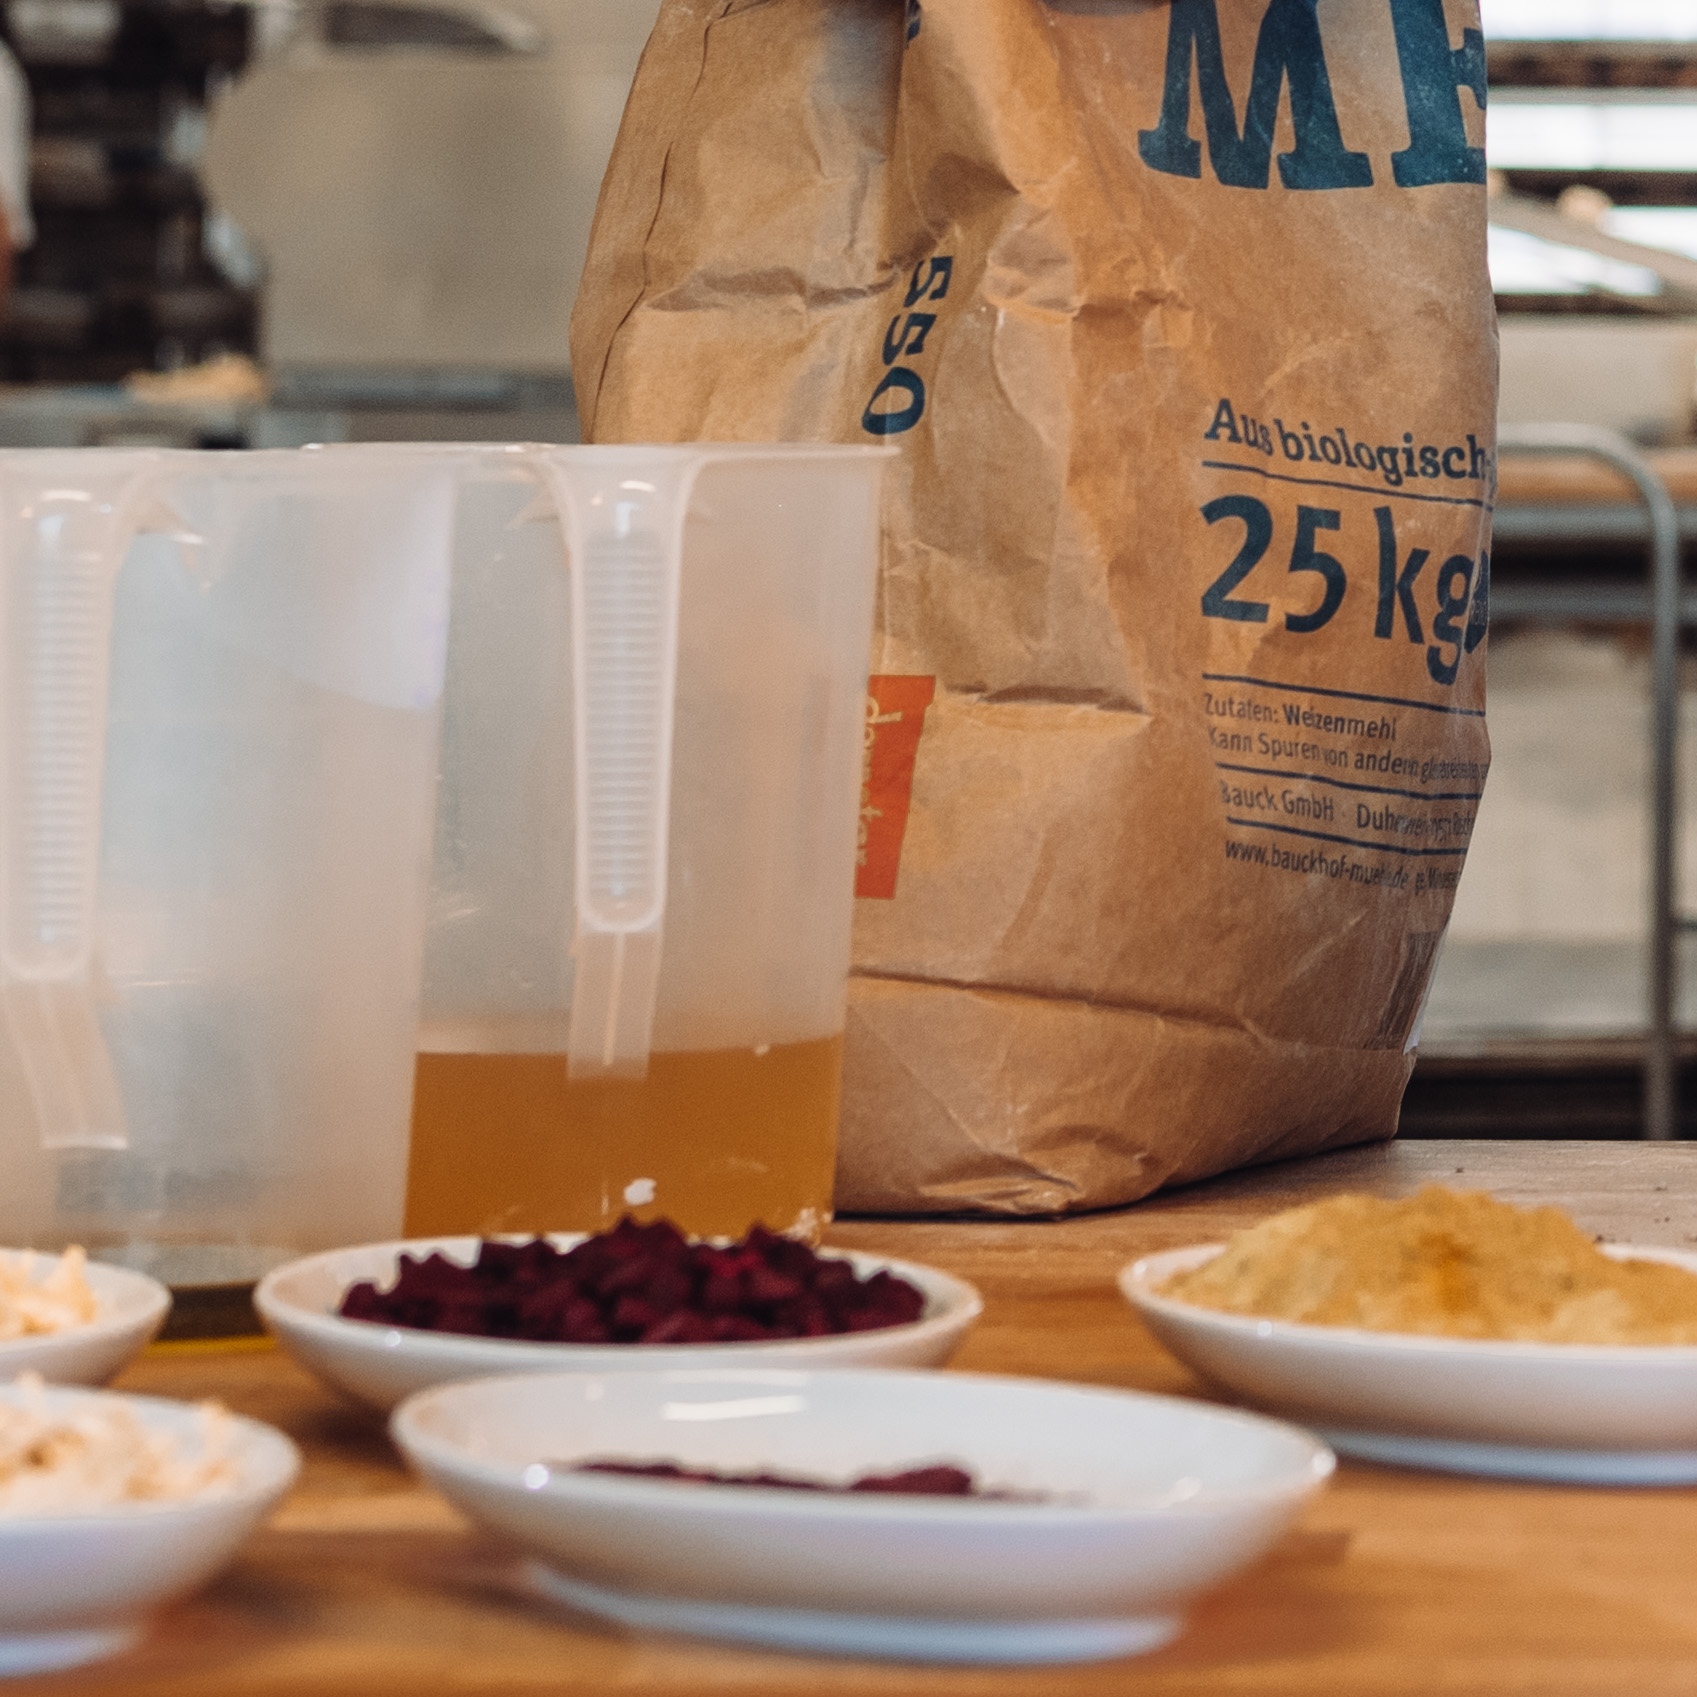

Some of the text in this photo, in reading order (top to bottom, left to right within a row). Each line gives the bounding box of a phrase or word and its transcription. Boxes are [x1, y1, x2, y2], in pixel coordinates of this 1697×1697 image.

[1203, 398, 1274, 456] Aus
[1199, 494, 1476, 685] 25 kg
[1282, 703, 1398, 742] Weizenmehl
[1257, 731, 1322, 763] Spuren
[1281, 789, 1336, 822] GmbH
